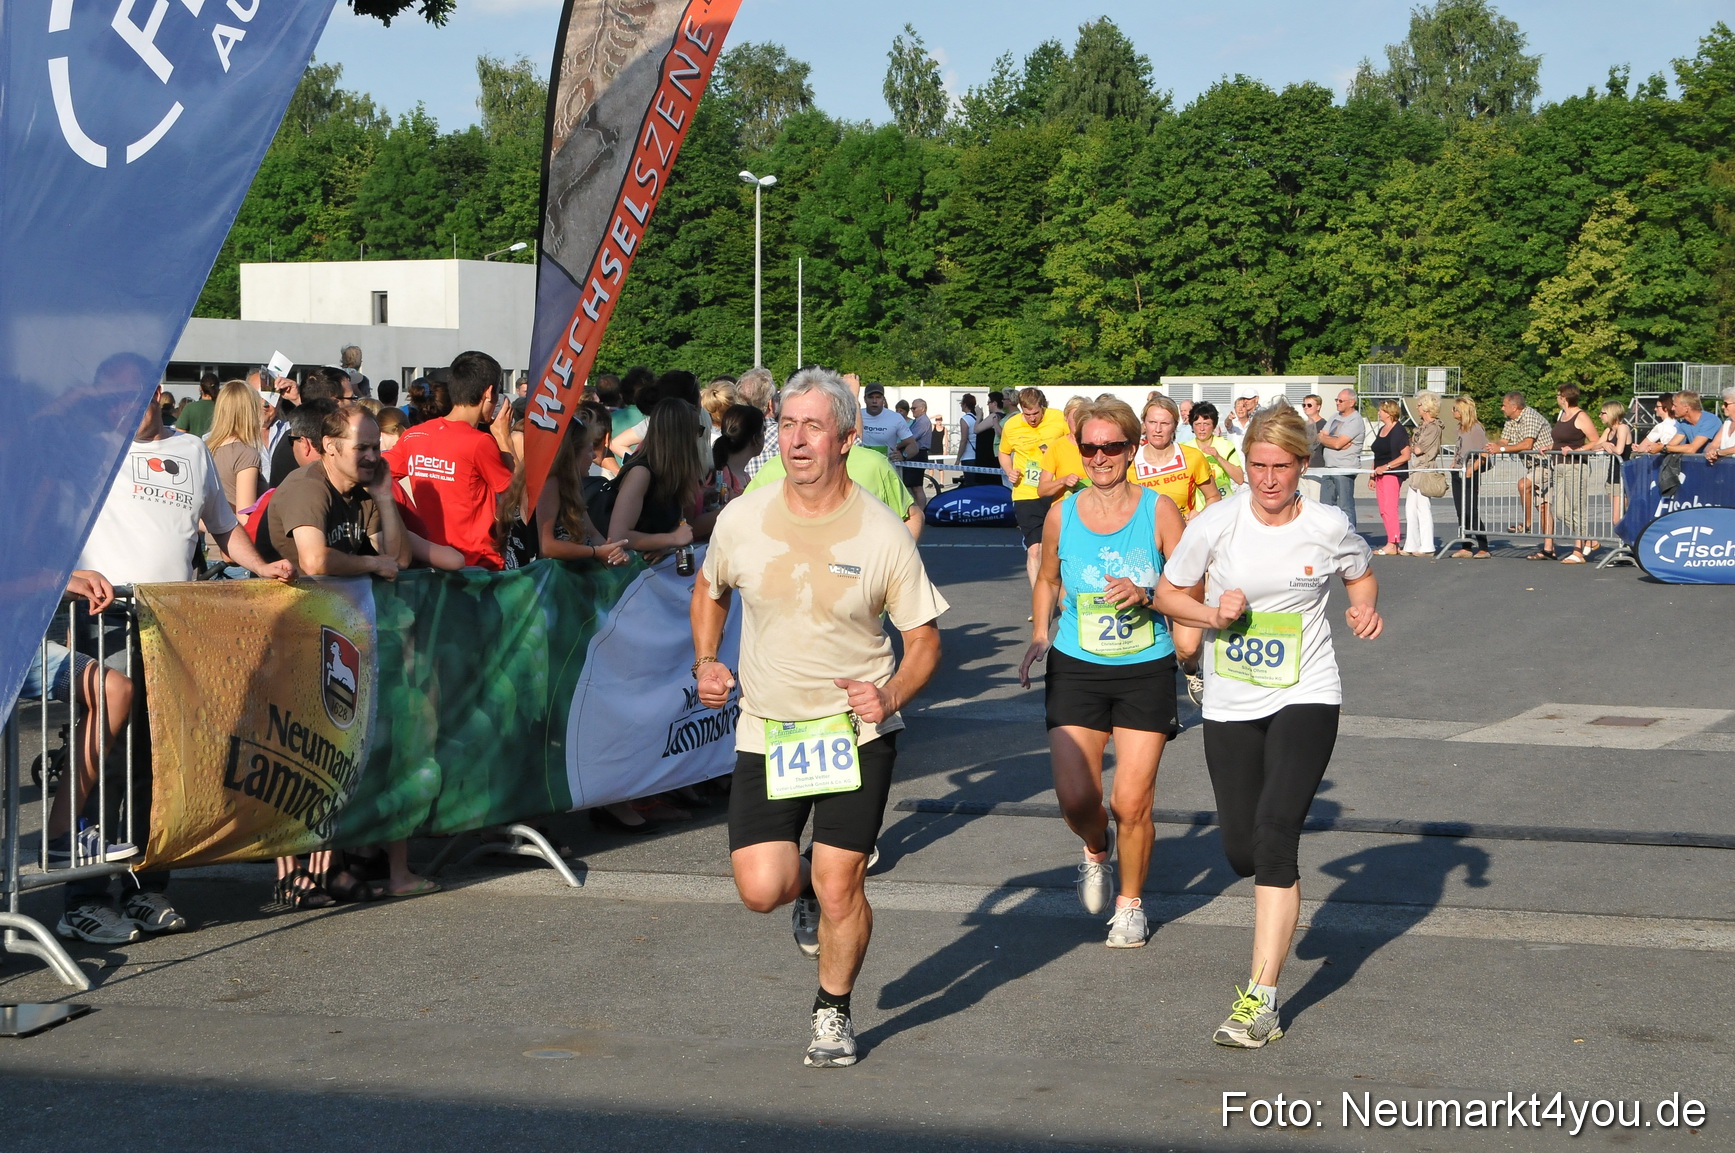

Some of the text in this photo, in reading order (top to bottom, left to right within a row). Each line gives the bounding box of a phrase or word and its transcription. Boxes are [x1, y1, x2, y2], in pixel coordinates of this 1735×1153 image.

[415, 454, 456, 475] Petry
[1163, 472, 1190, 485] BÖGL
[132, 484, 194, 506] POLGER
[132, 494, 194, 511] TRANSPORT
[949, 503, 1008, 521] Fischer
[828, 563, 862, 576] VETTER
[1098, 614, 1133, 640] 26
[1226, 633, 1285, 668] 889
[770, 738, 854, 777] 1418
